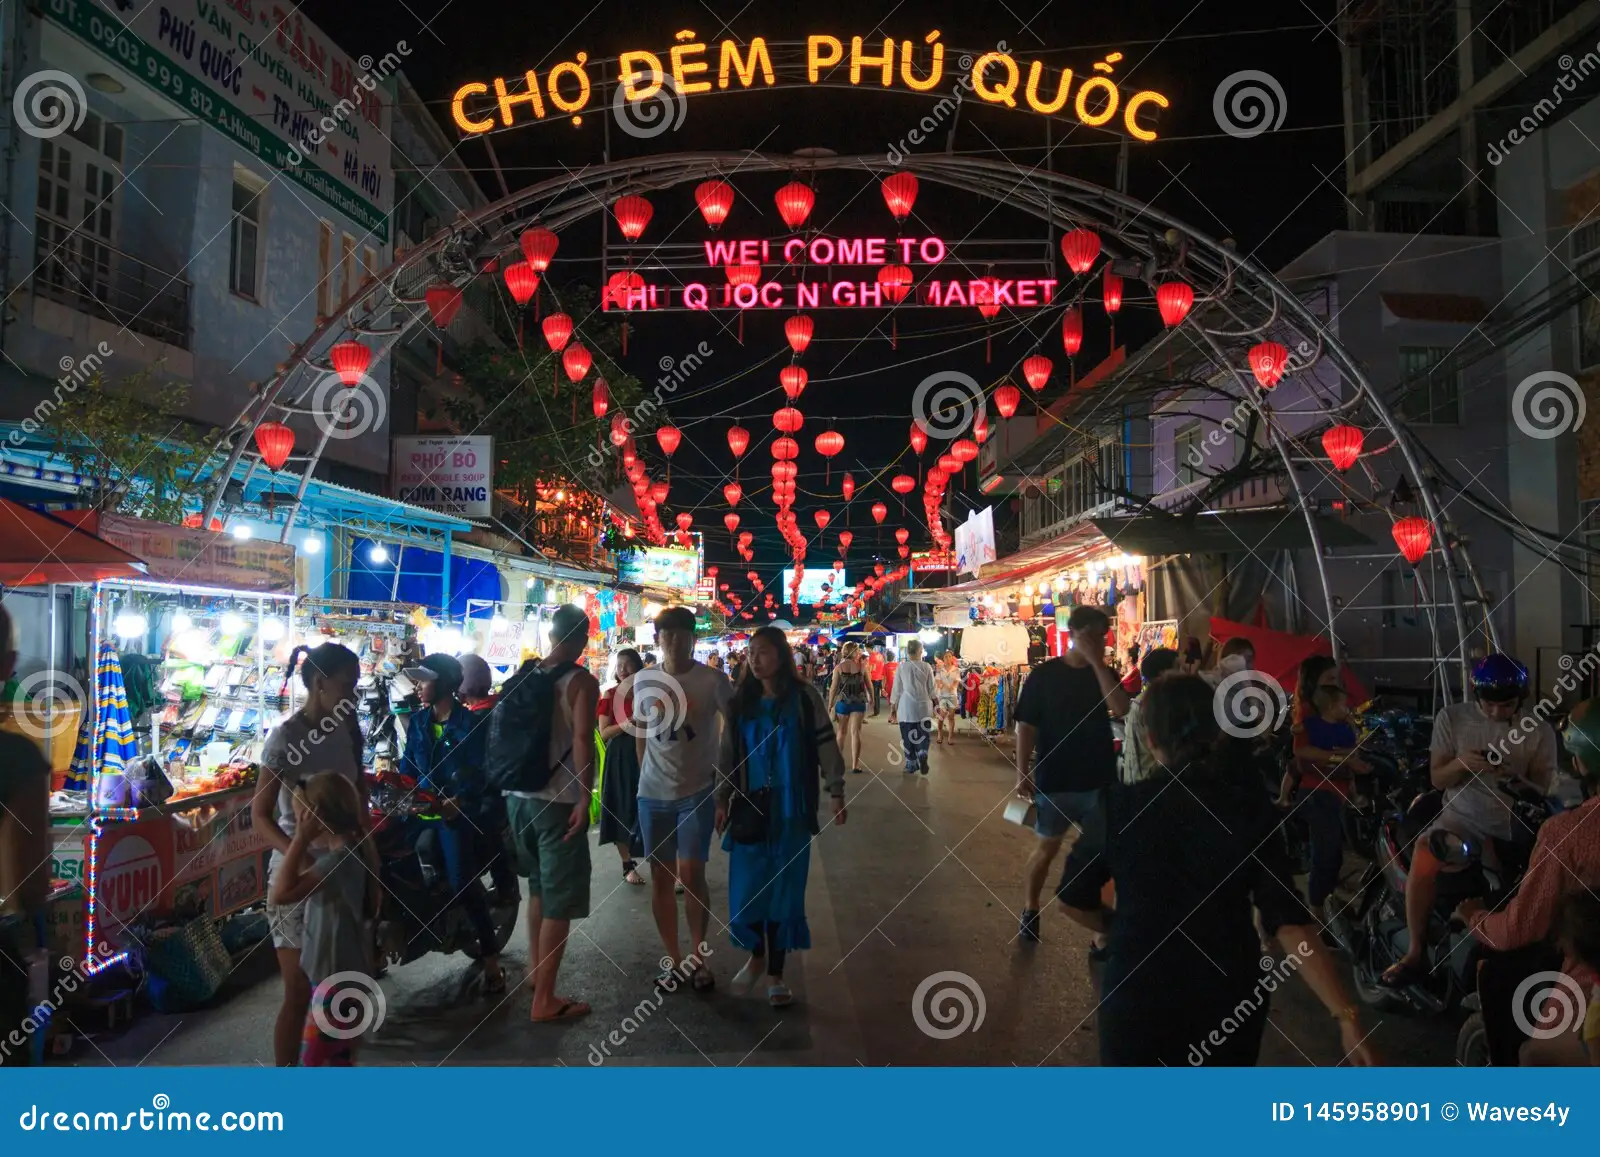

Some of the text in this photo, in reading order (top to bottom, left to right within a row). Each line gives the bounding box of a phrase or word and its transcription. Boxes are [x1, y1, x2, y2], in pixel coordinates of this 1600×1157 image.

[89, 16, 140, 66] 0903
[145, 56, 184, 96] 999
[189, 87, 213, 118] 812
[159, 6, 196, 60] PHÚ
[199, 40, 243, 96] QUỐC
[452, 29, 1170, 141] CHỢ ĐÊM PHÚ QUỐC
[896, 236, 948, 266] TO
[410, 447, 477, 469] PHỞ BÒ
[462, 473, 485, 482] SOUP
[399, 486, 486, 502] CƠM RANG
[101, 864, 159, 918] YUMI
